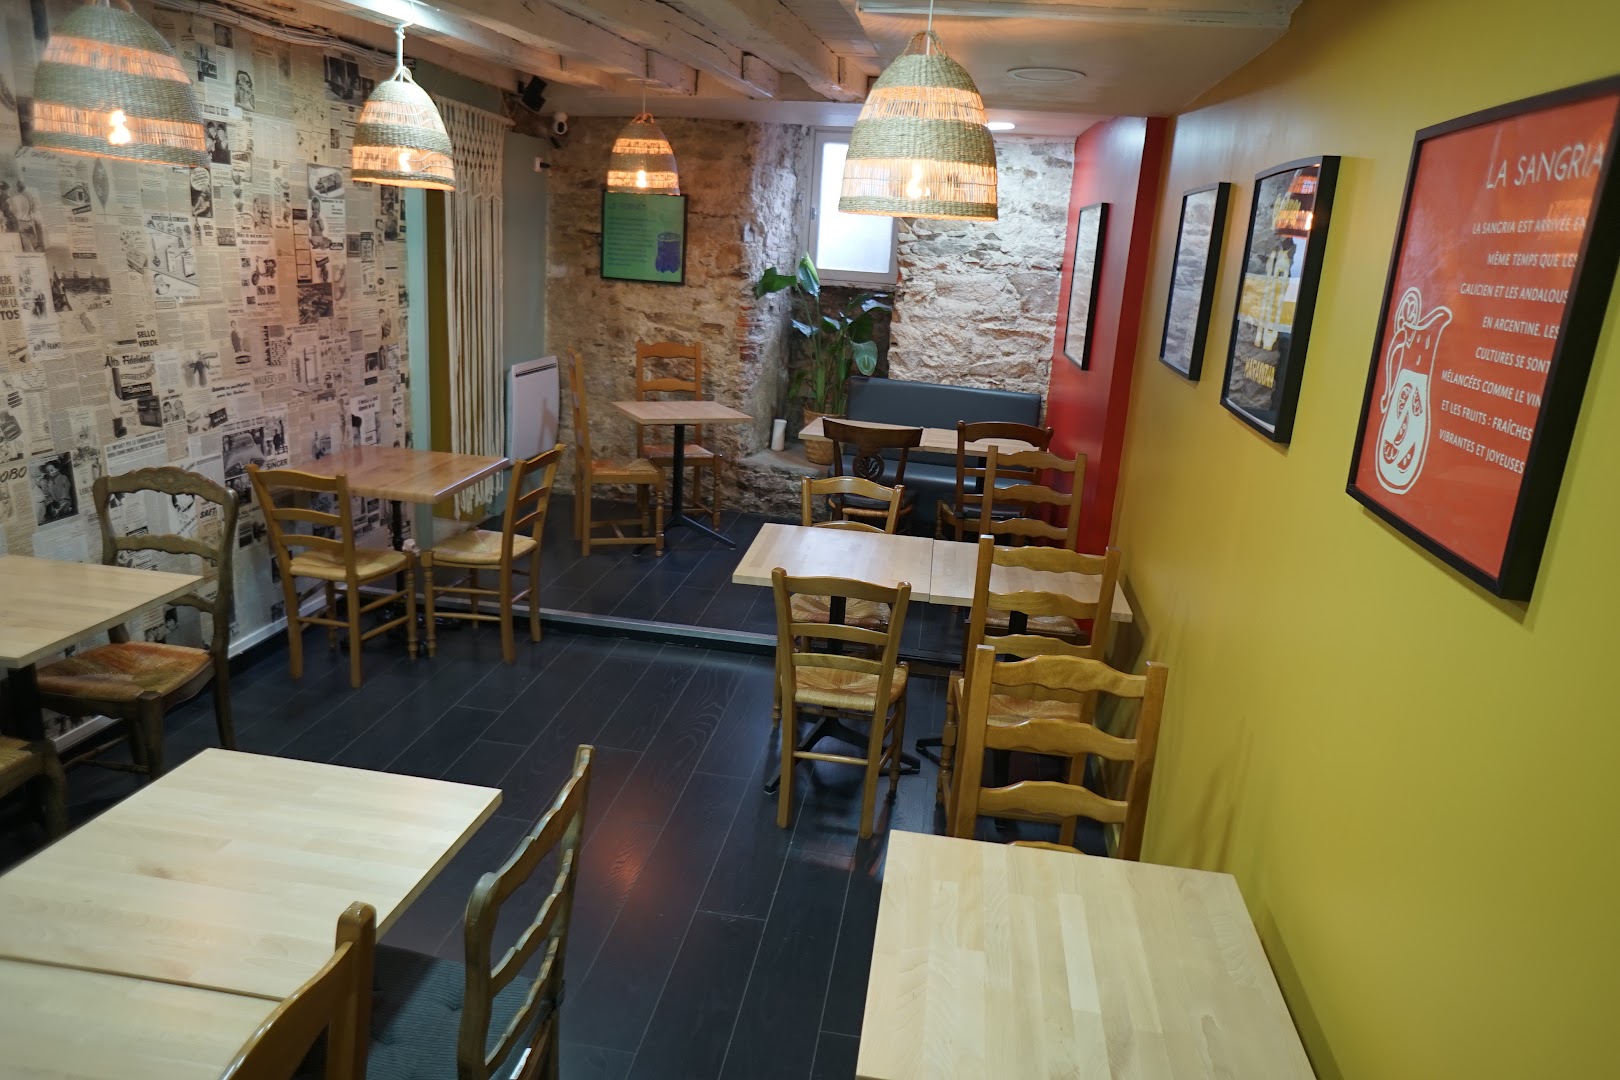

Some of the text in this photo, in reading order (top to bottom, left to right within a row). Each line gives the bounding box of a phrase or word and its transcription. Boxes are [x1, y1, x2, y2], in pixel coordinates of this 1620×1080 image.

[1486, 143, 1604, 189] LA SANGRIA
[1472, 223, 1481, 235] LA
[1481, 221, 1515, 234] SANGRIA
[1517, 220, 1533, 233] EST
[1534, 216, 1571, 232] ARRIVÉE
[1487, 251, 1578, 268] MÊME TEMPS QUE LES
[1494, 285, 1505, 298] ET
[1505, 286, 1519, 300] LES
[137, 330, 156, 339] SELLO
[1482, 316, 1493, 329] EN
[1543, 324, 1560, 340] LES
[138, 339, 159, 348] VERDE
[1475, 347, 1551, 374] CULTURES SE SONT
[1441, 368, 1542, 408] MÉLANGÉES COMME LE VIN
[1441, 400, 1450, 411] ET
[1450, 403, 1462, 416] LES
[1462, 406, 1488, 426] FRUITS
[1492, 416, 1534, 442] FRAÎCHES
[1439, 428, 1525, 475] VIBRANTES ET JOYEUSES
